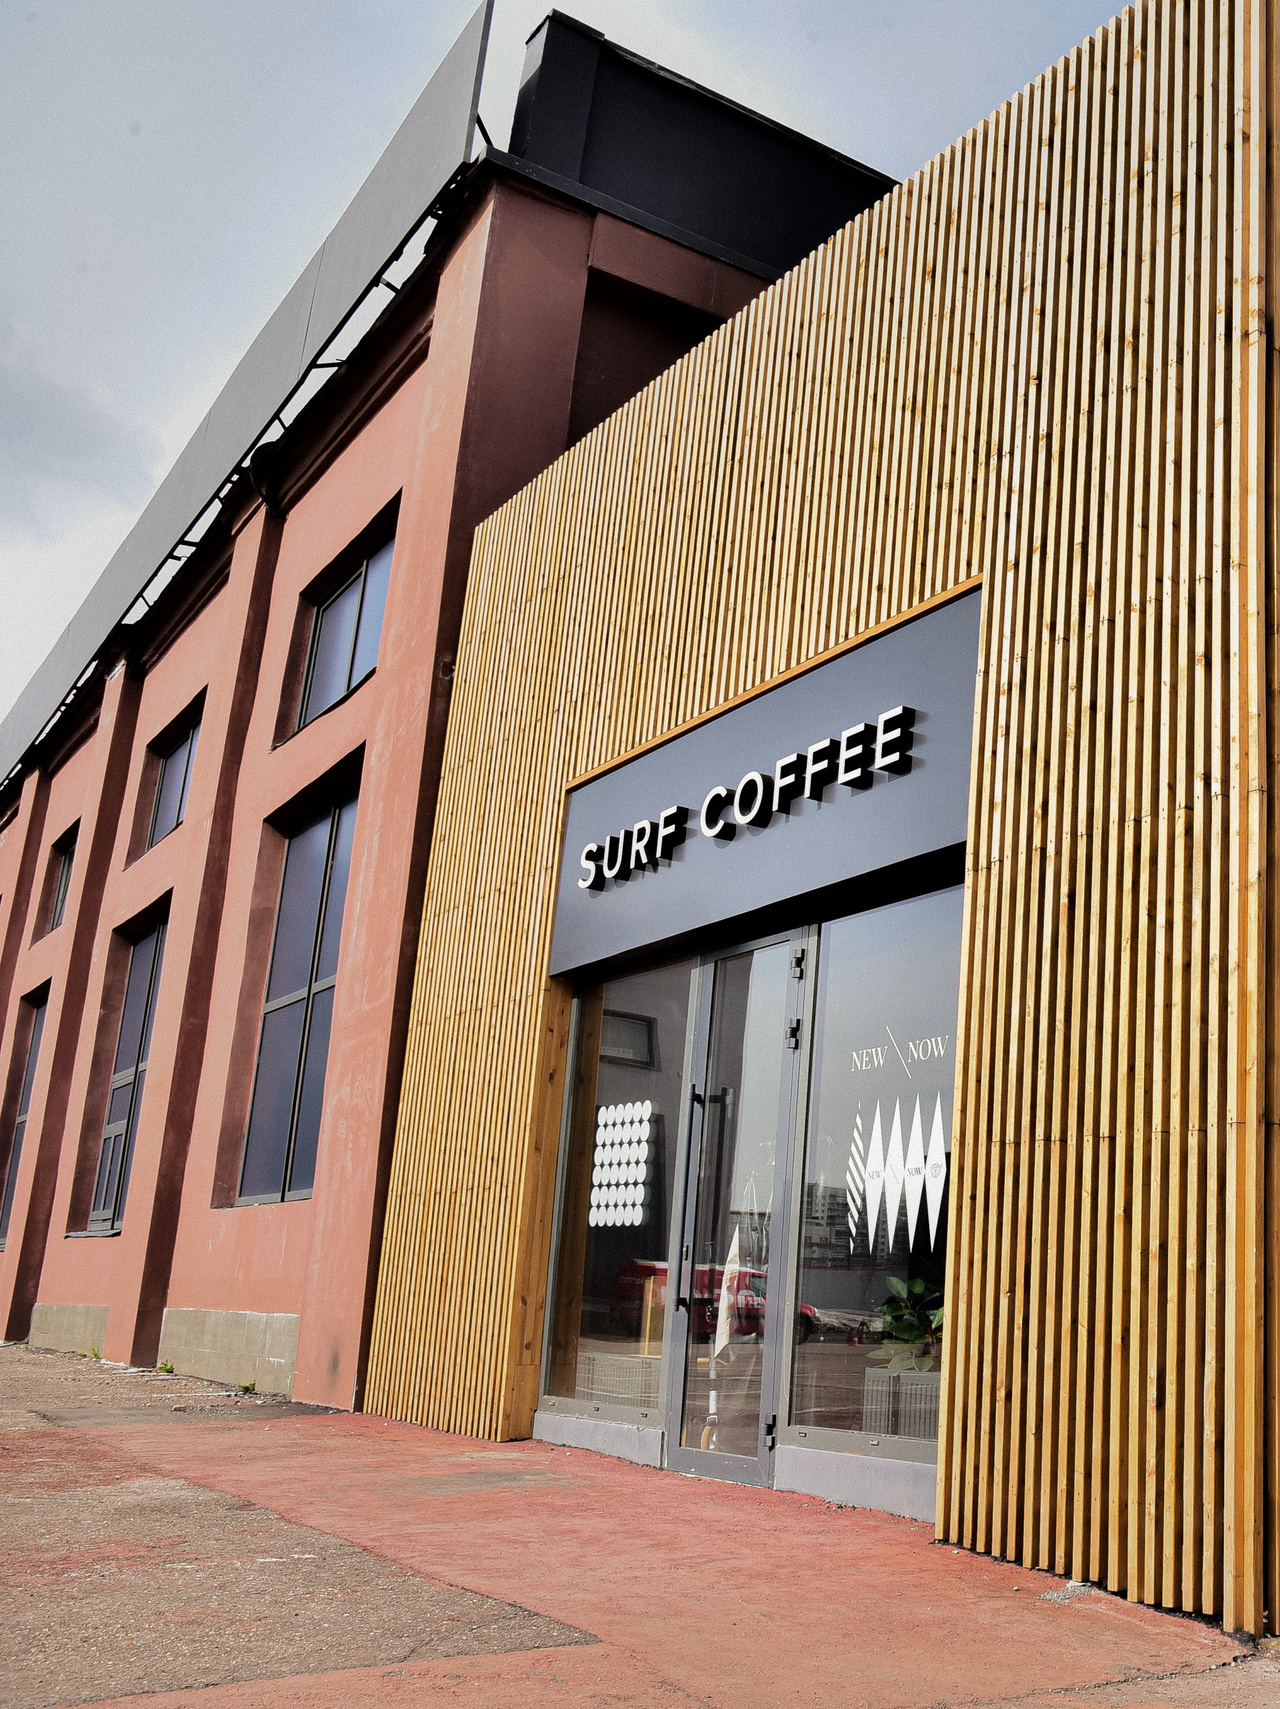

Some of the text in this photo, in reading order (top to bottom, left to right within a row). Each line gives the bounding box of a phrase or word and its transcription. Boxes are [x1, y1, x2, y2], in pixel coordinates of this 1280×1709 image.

[577, 705, 905, 889] SURF COFFEE
[850, 1035, 949, 1072] NEW NOW
